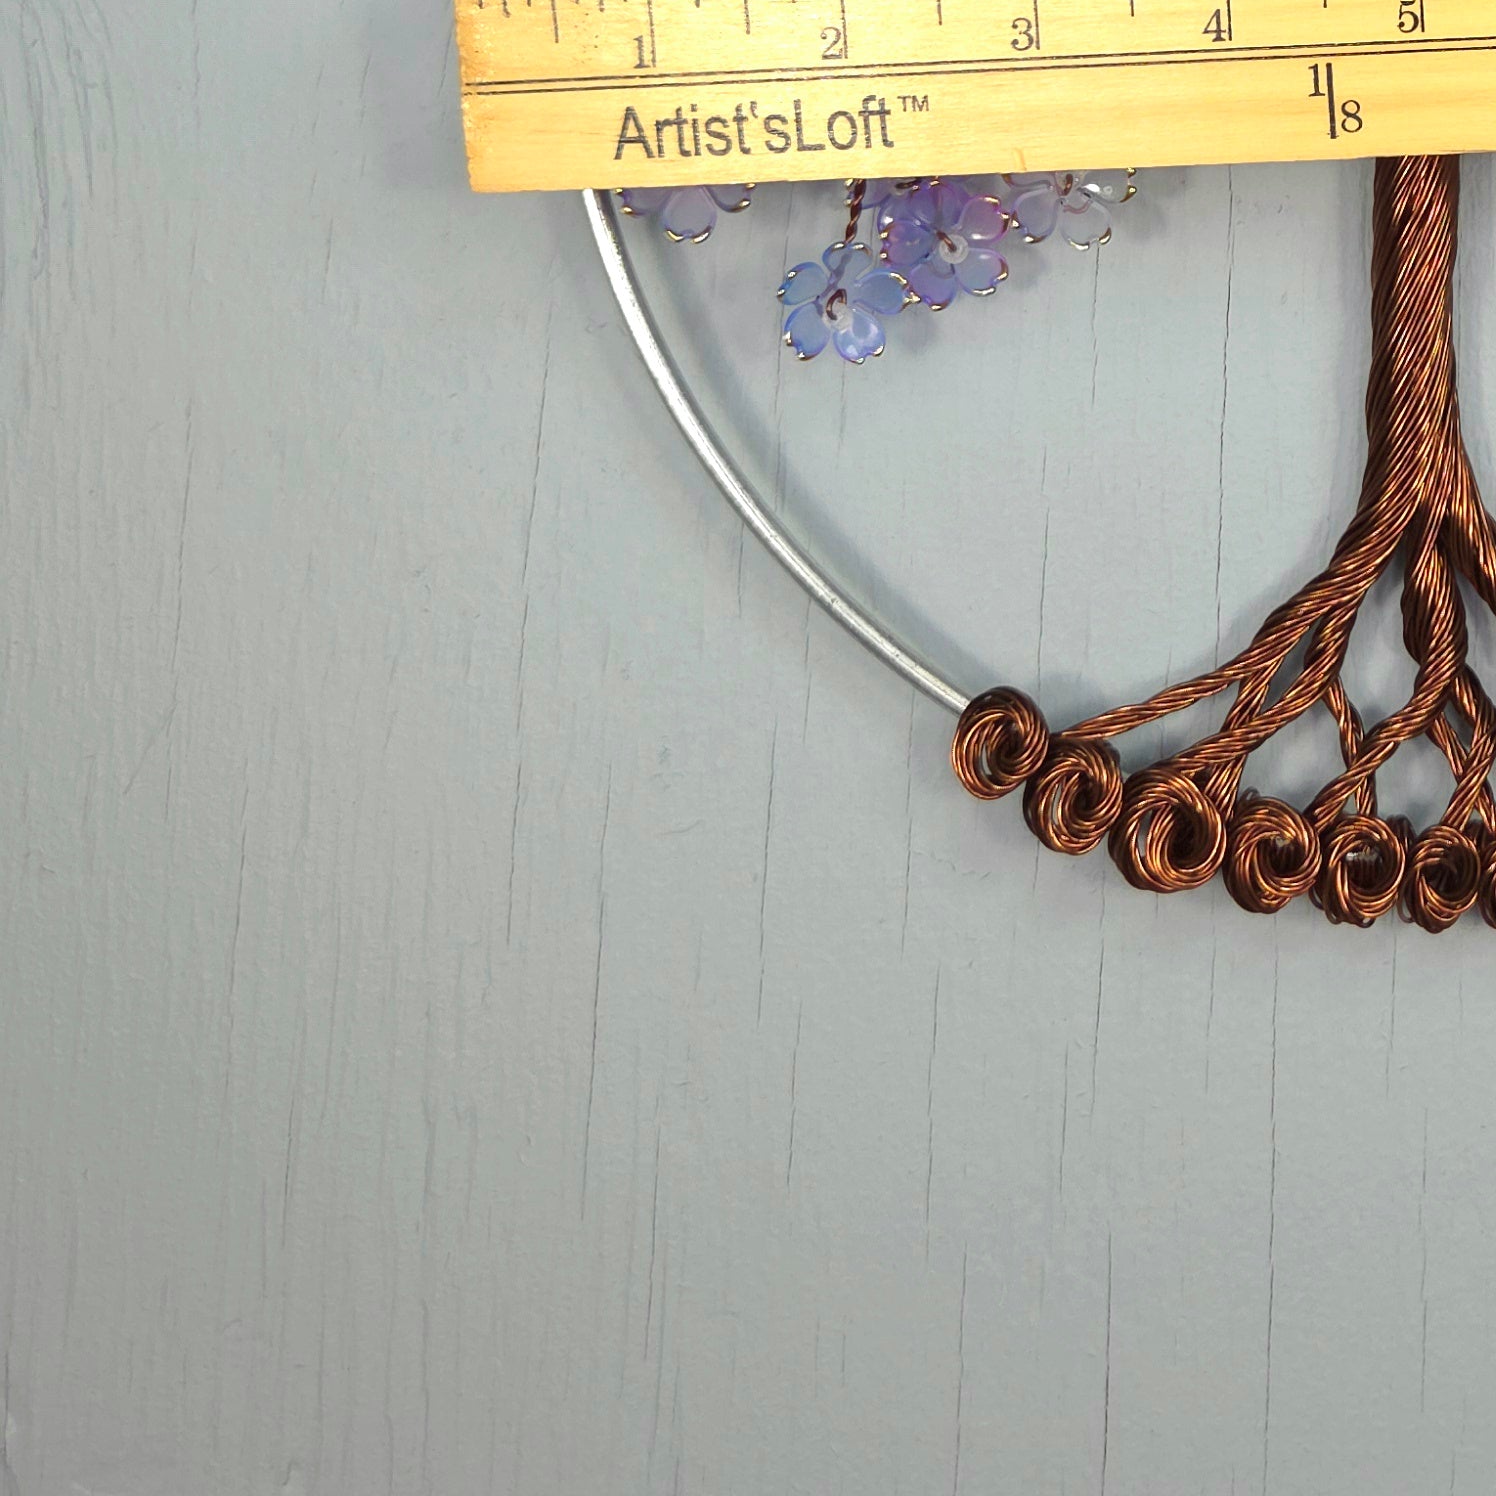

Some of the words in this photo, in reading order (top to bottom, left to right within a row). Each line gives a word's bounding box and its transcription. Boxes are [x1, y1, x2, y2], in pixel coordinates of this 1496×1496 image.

[632, 34, 647, 69] 1
[820, 26, 843, 60] 2
[1010, 17, 1034, 52] 3
[1202, 8, 1227, 43] 4
[1397, 0, 1419, 34] 5
